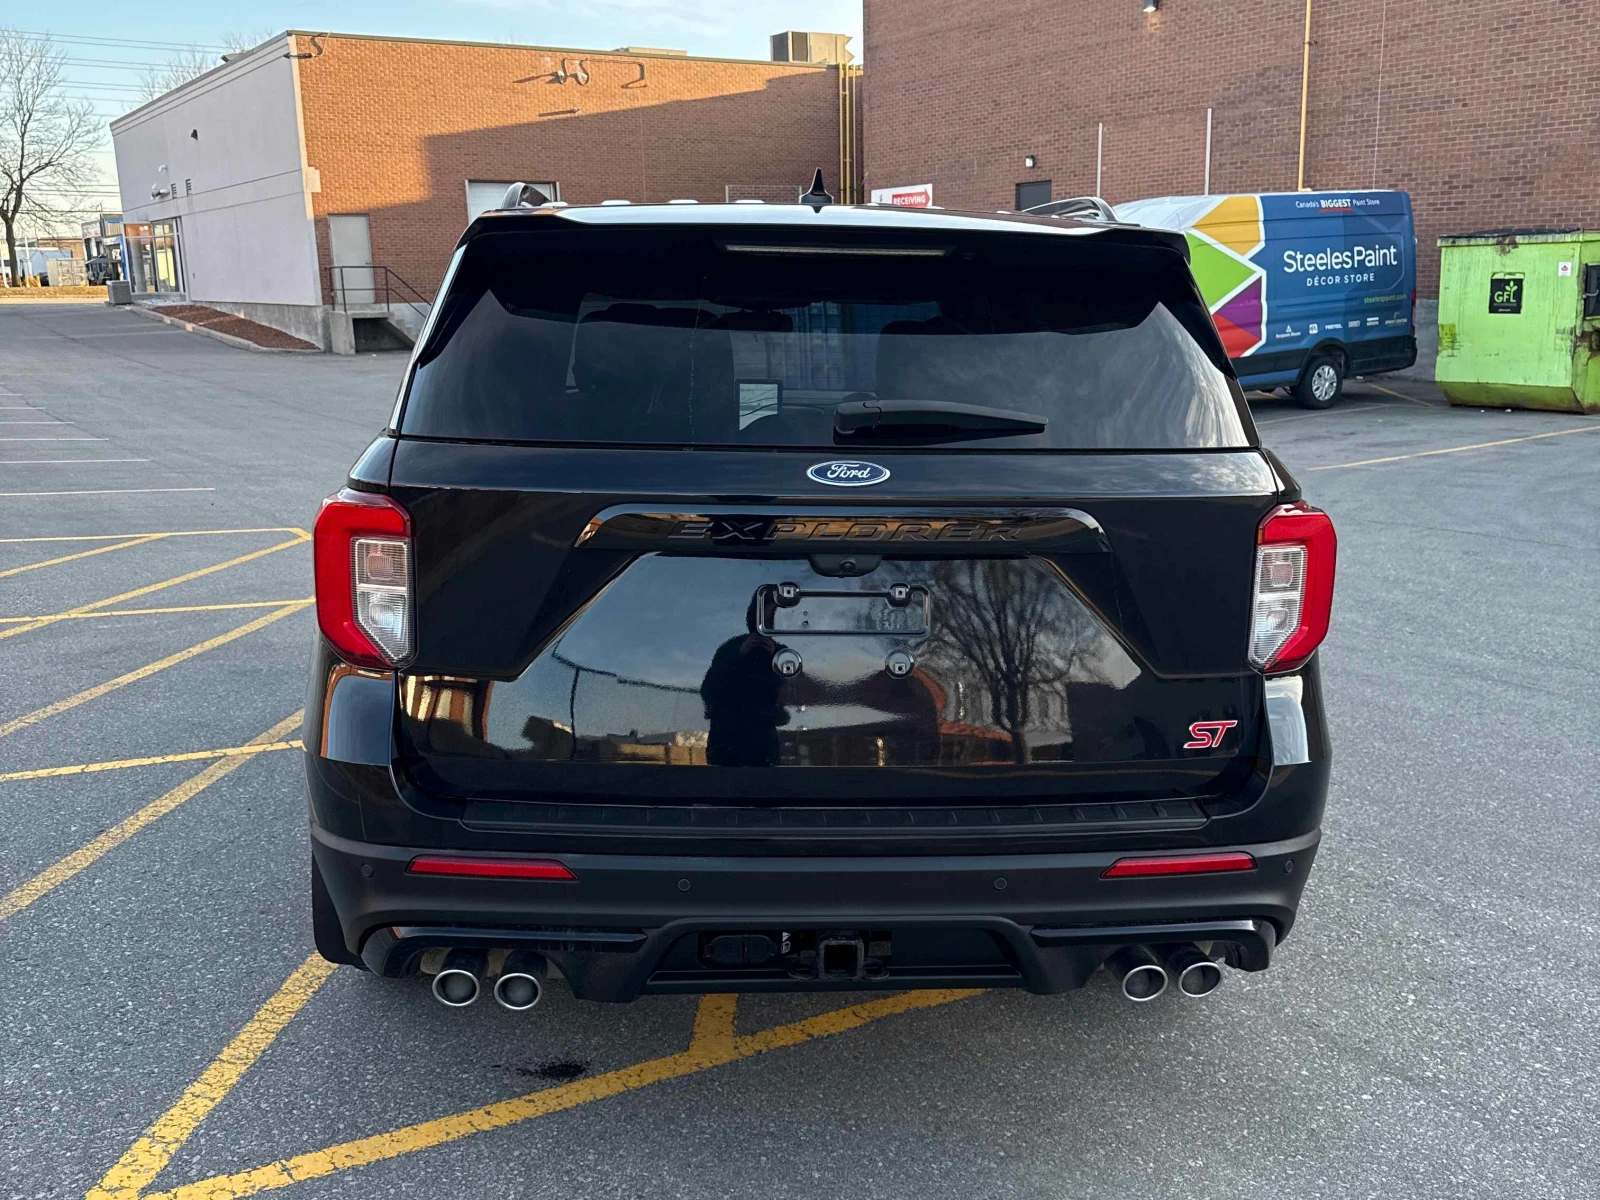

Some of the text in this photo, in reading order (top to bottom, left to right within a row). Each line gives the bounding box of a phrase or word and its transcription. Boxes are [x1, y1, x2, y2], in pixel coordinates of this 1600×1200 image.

[893, 195, 926, 205] RECEIVING
[1320, 199, 1351, 208] BIGGEST
[1366, 198, 1380, 206] Store
[1306, 273, 1375, 287] DÉCOR STORE
[1494, 284, 1518, 303] GFL
[827, 463, 871, 478] Ford
[667, 519, 1024, 542] EXPLORER
[1183, 720, 1238, 749] ST
